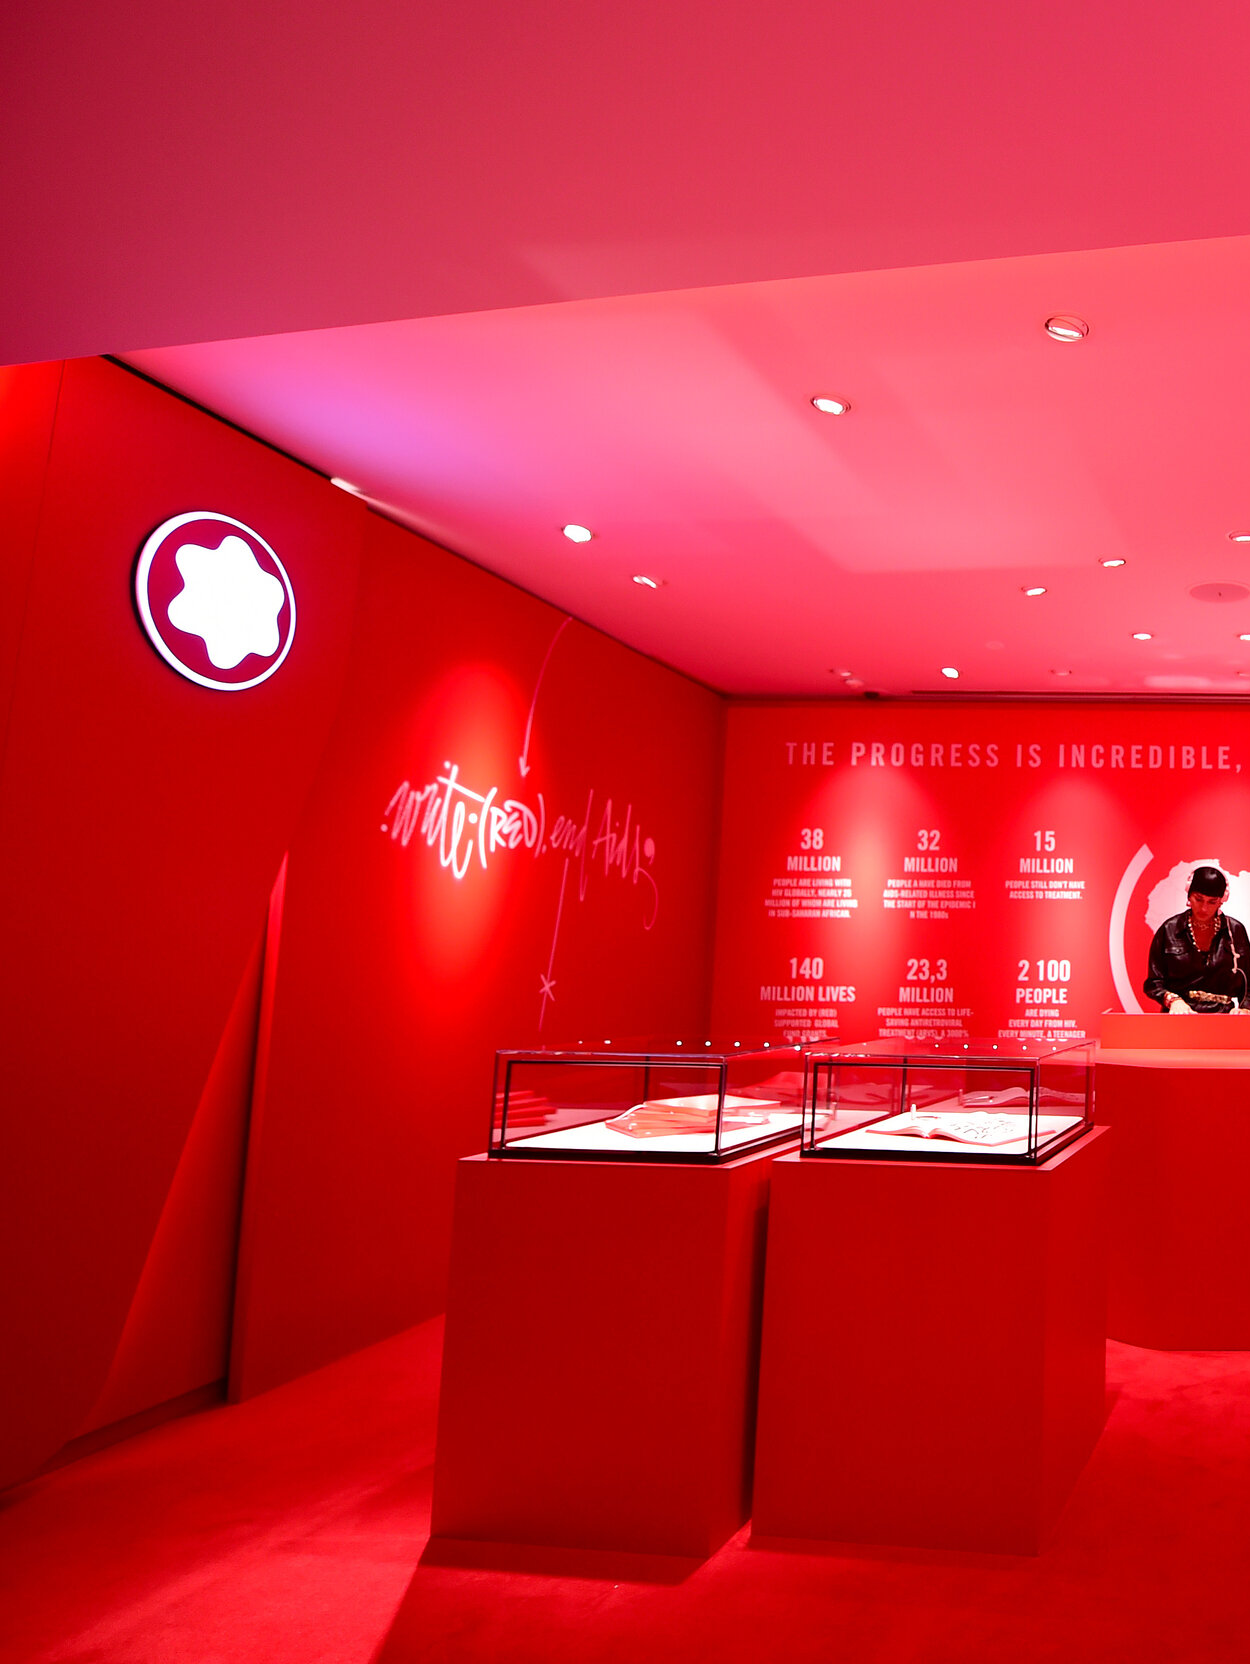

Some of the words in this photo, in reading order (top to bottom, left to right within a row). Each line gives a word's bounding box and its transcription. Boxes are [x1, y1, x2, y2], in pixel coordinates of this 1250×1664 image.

[786, 742, 834, 765] THE
[851, 742, 998, 767] PROGRESS
[1017, 744, 1041, 768] IS
[1059, 744, 1241, 773] INCREDIBLE,
[801, 828, 823, 849] 38
[917, 829, 940, 851] 32
[1034, 830, 1055, 851] 15
[787, 856, 841, 871] MILLION
[904, 857, 958, 872] MILLION
[1020, 858, 1073, 873] MILLION
[1005, 880, 1029, 889] PEOPLE
[1031, 881, 1047, 889] STILL
[1009, 891, 1034, 899] ACCESS
[1035, 891, 1043, 899] TO
[790, 957, 823, 979] 140
[907, 958, 947, 983] 23,3
[1018, 960, 1029, 981] 2
[1037, 960, 1071, 981] 100
[760, 986, 814, 1001] MILLION
[818, 986, 856, 1002] LIVES
[899, 987, 953, 1003] MILLION
[1016, 988, 1067, 1004] PEOPLE
